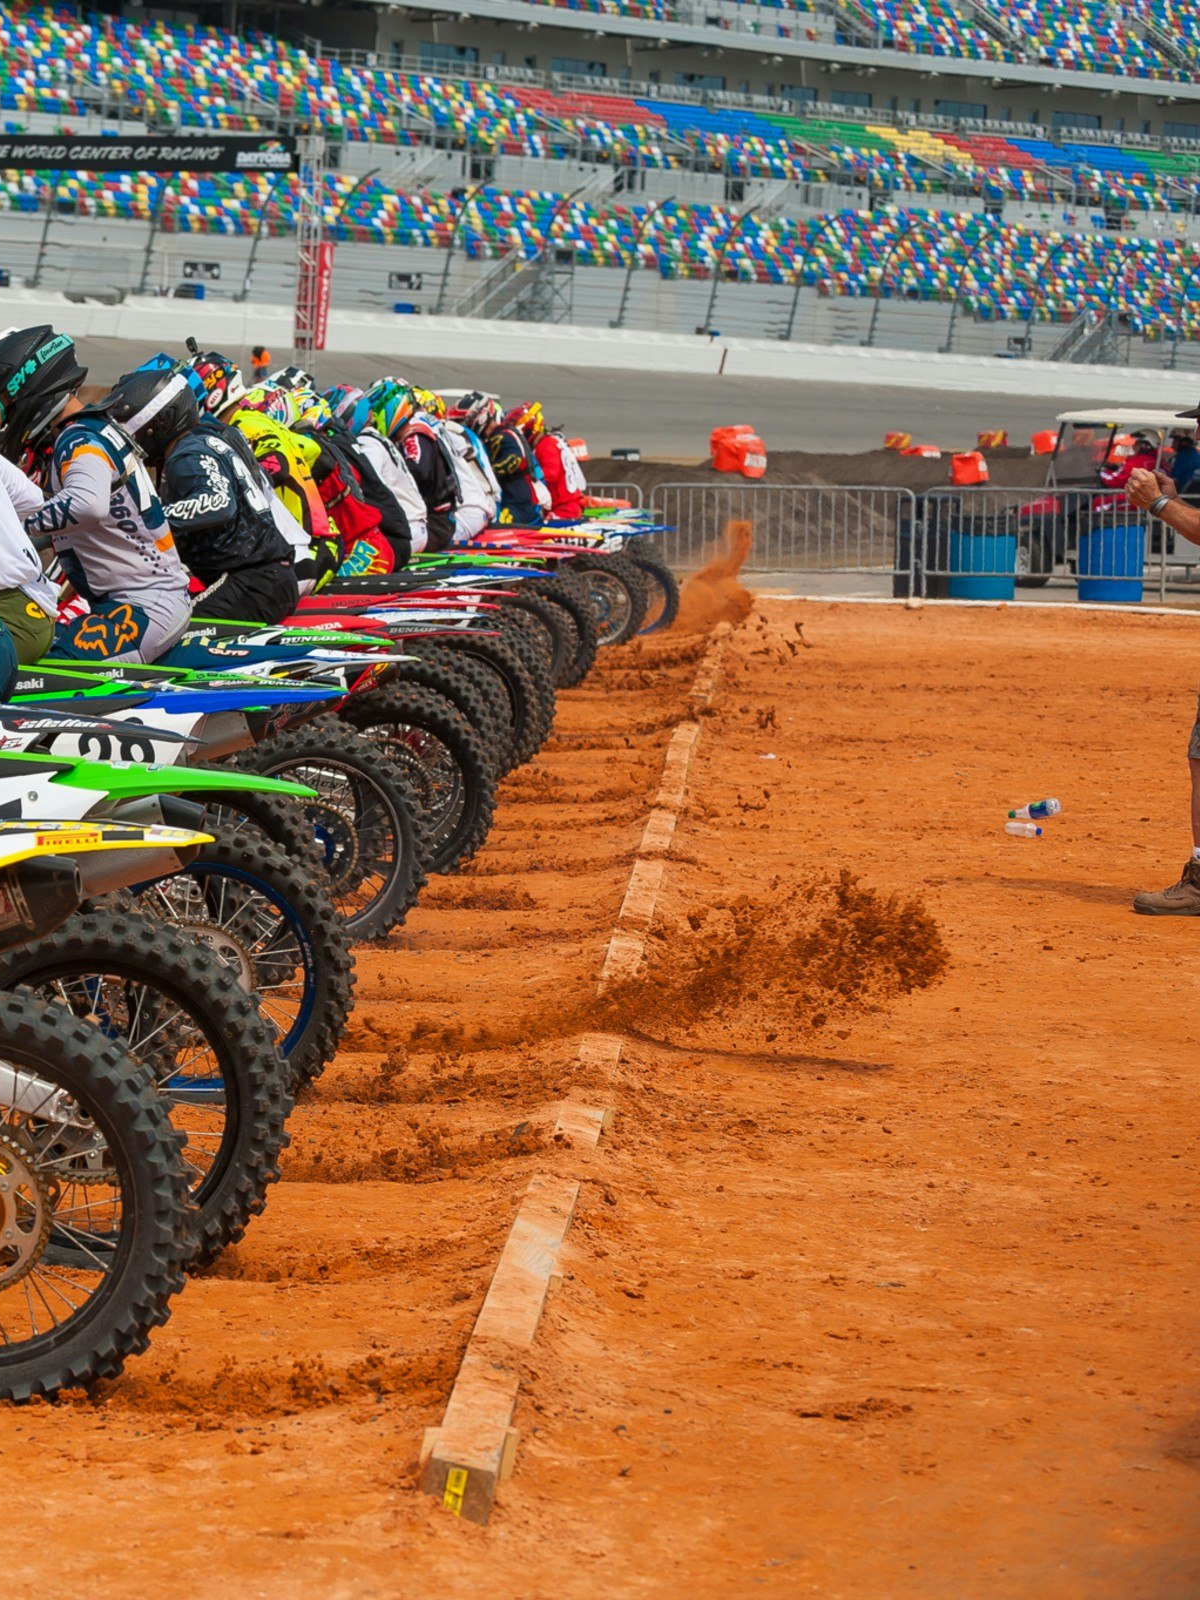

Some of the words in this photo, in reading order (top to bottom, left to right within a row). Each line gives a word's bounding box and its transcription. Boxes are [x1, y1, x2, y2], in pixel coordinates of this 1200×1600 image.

[10, 145, 66, 159] WORLD
[68, 146, 132, 160] CENTER
[133, 146, 155, 160] OF
[156, 146, 223, 161] RACING
[389, 625, 438, 634] DUNLOP
[280, 636, 340, 645] DUNLOP
